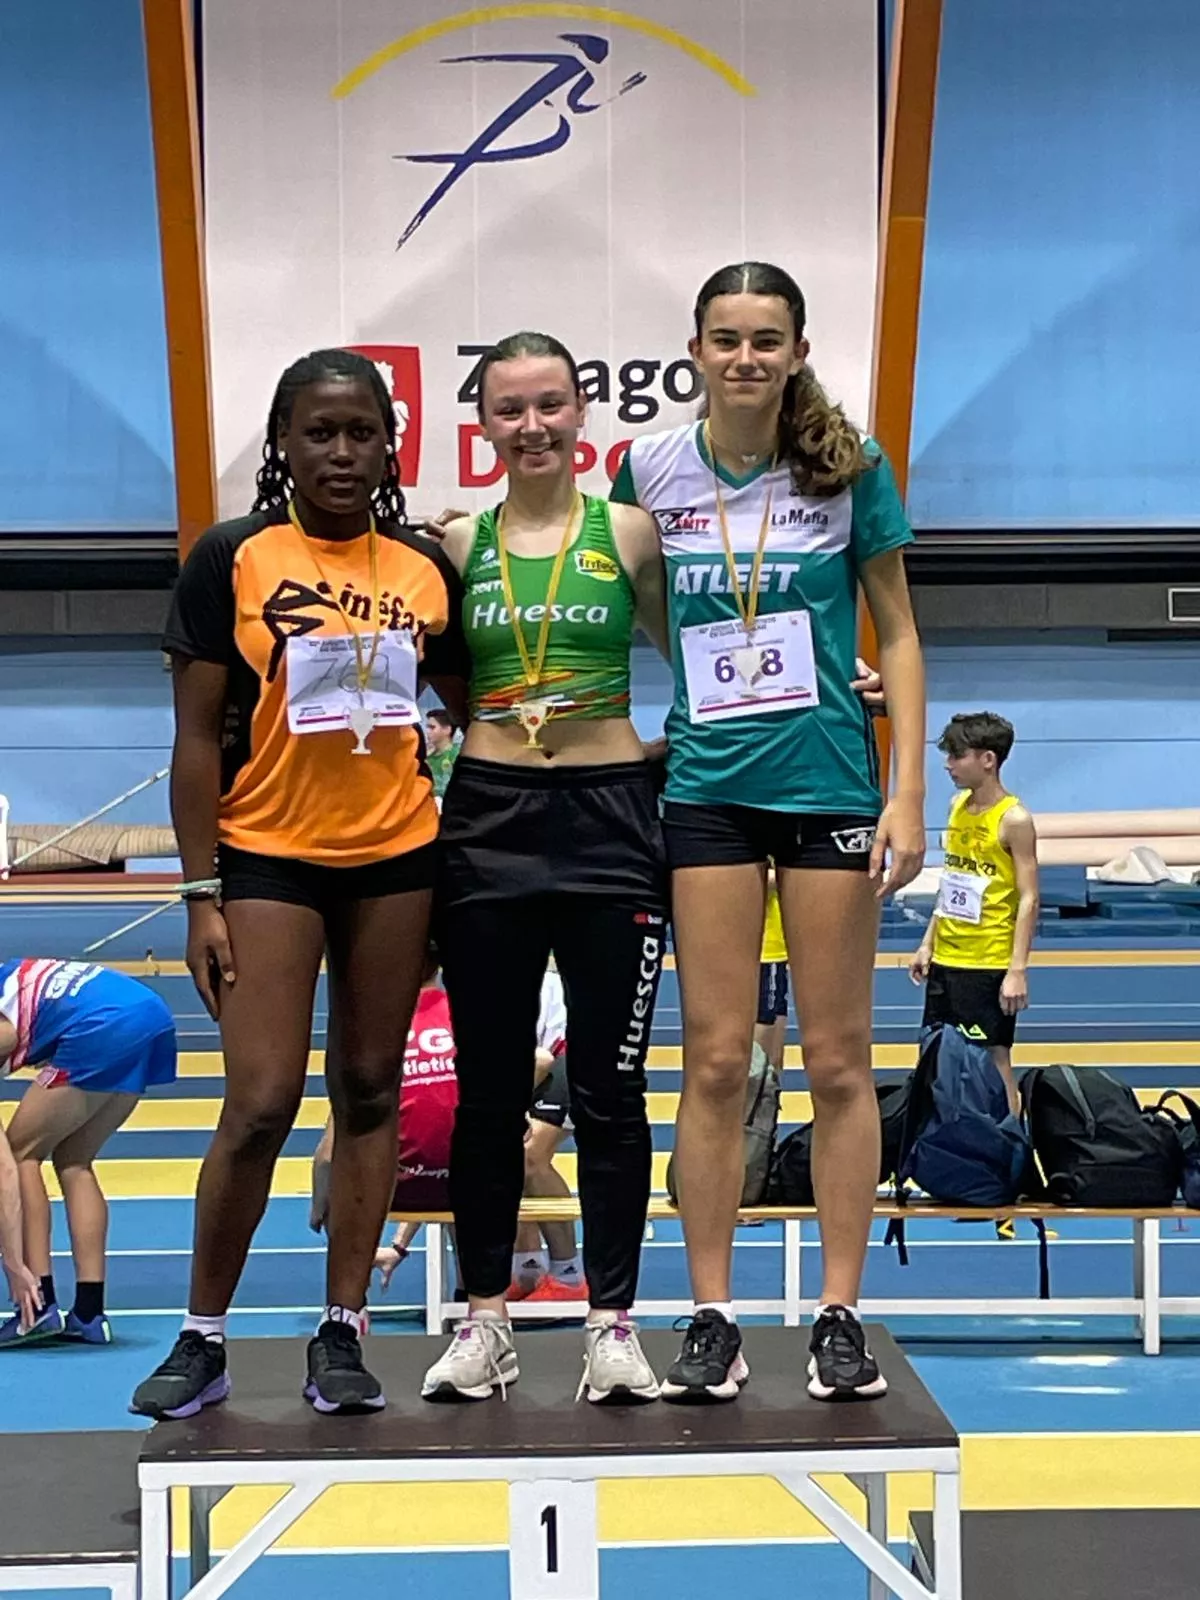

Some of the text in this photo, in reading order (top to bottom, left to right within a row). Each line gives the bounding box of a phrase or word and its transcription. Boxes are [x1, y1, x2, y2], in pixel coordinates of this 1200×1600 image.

[471, 602, 609, 629] Huesca
[714, 648, 784, 684] 68
[617, 936, 659, 1071] Huesca
[541, 1505, 558, 1573] 1
